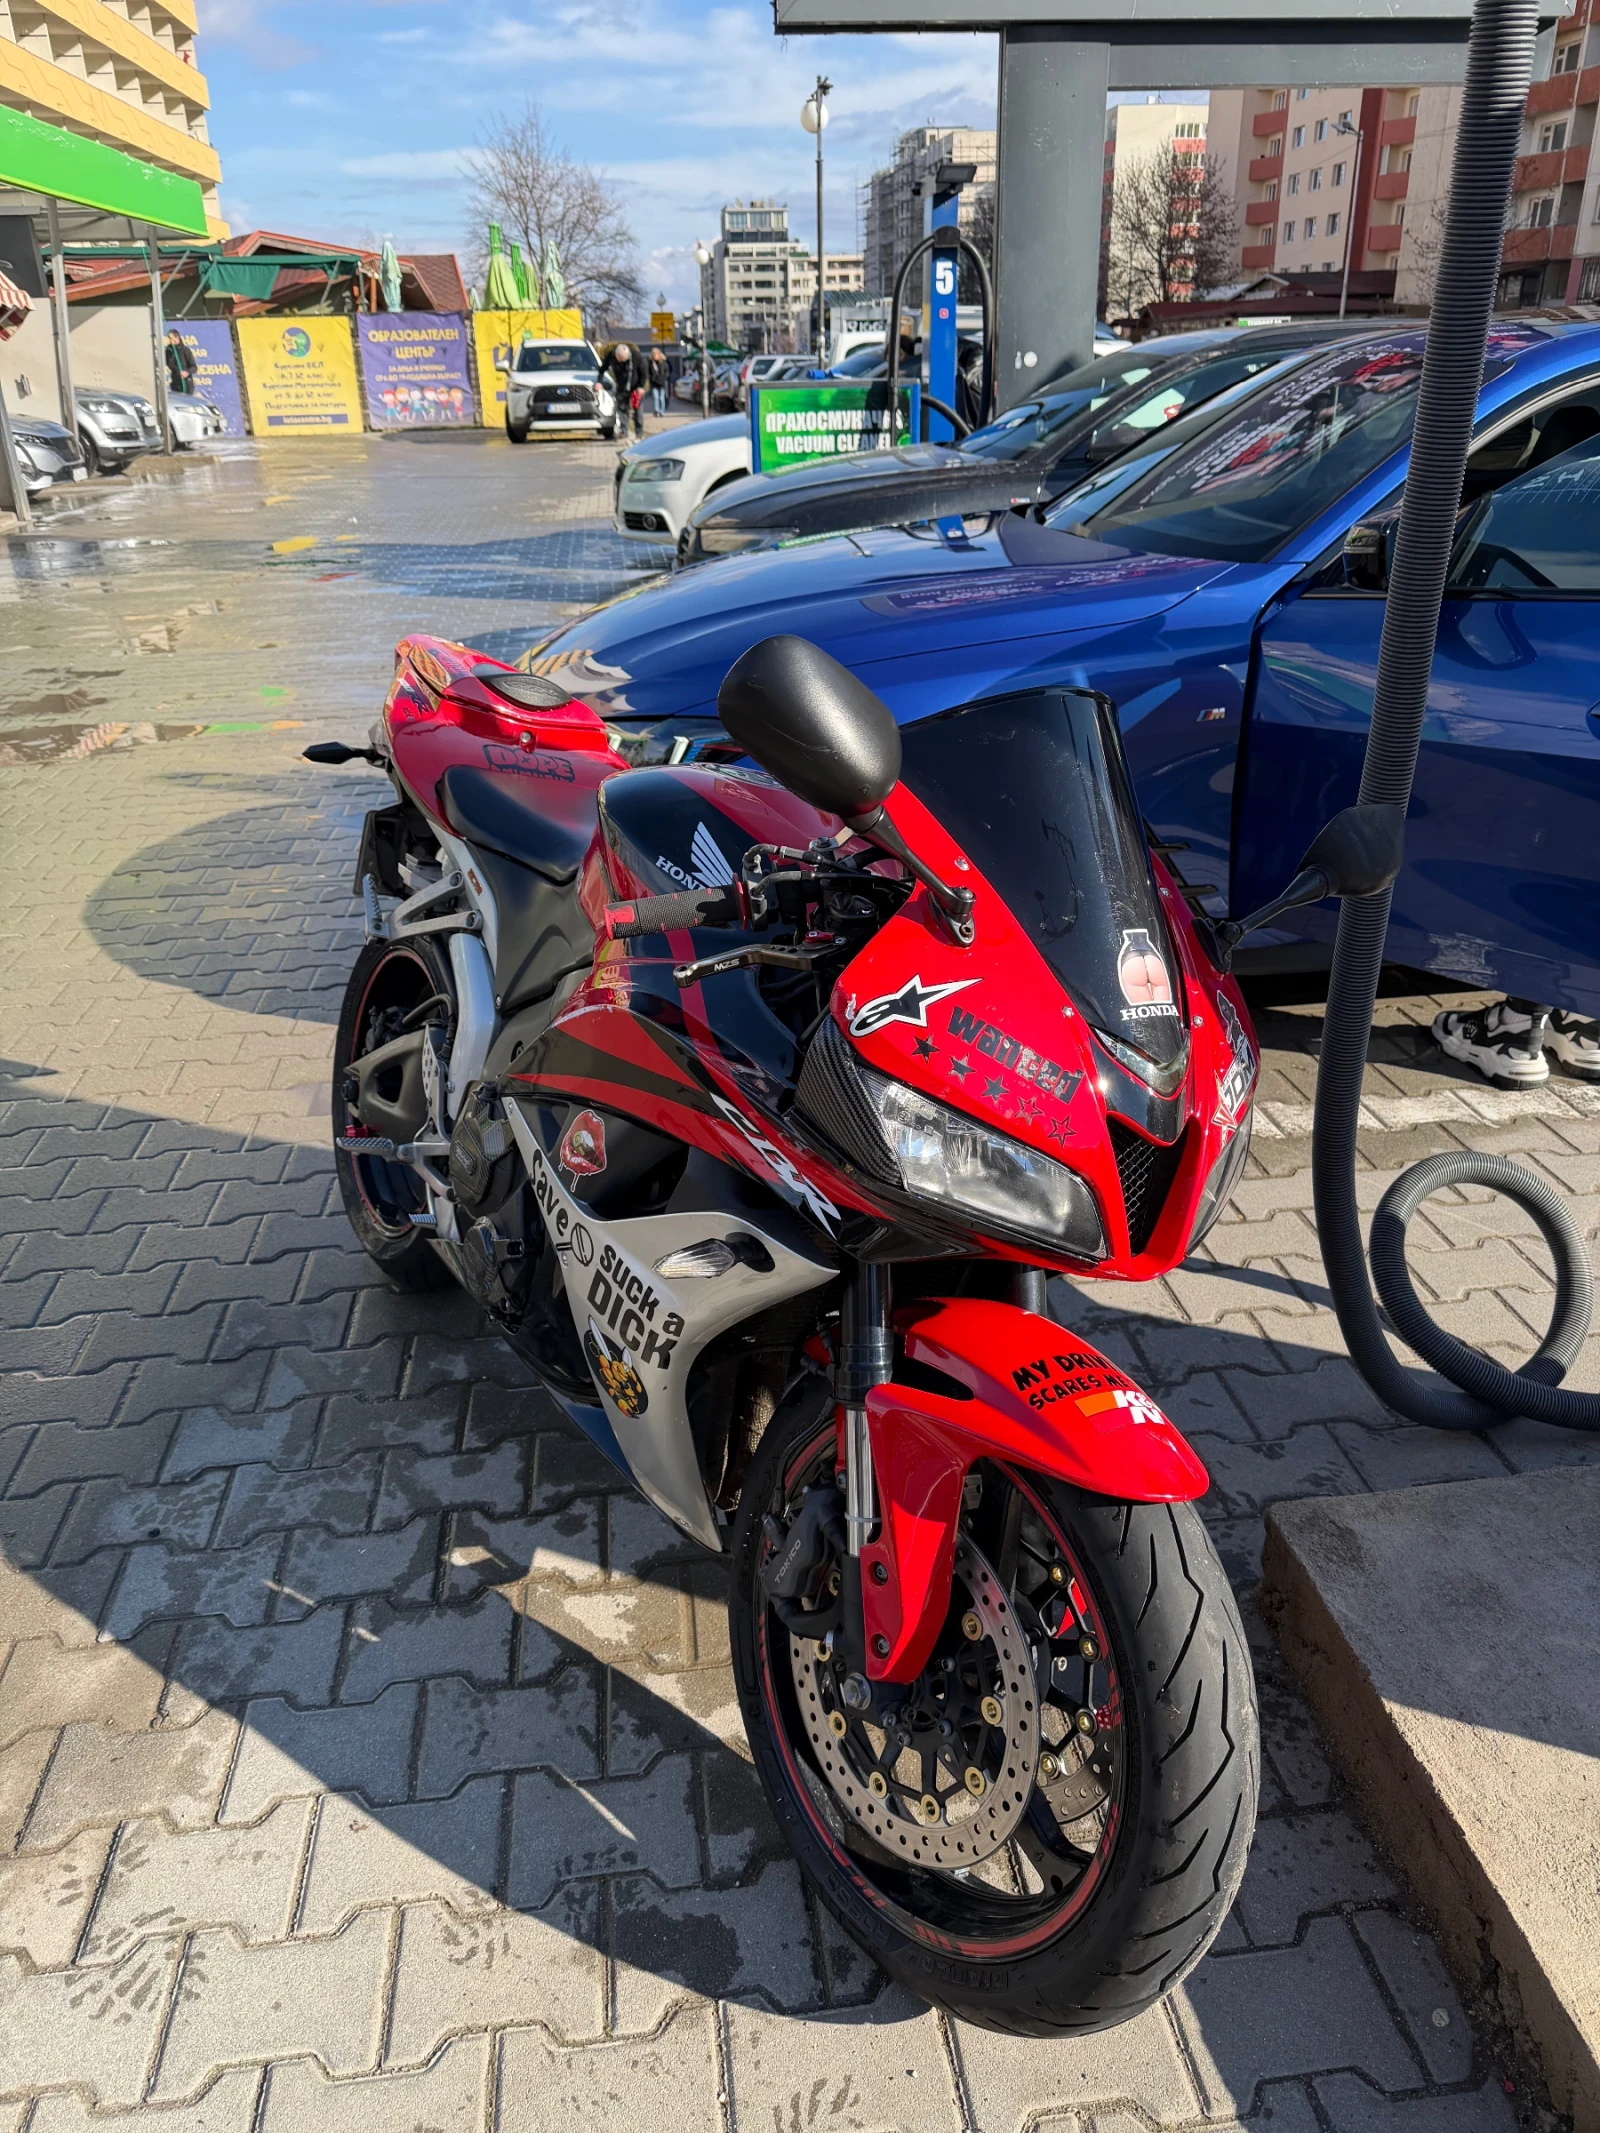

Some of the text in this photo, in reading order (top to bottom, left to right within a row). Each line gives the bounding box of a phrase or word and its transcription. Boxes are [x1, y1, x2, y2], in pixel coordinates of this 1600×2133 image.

[936, 261, 953, 295] 5
[368, 328, 459, 342] ОБРАЗОВАТЕЛЕН
[395, 346, 436, 359] ЦЕНТЪР
[775, 434, 835, 454] VACUUM
[482, 744, 576, 783] DOPE
[655, 856, 706, 890] HON
[714, 958, 740, 971] MZS
[1120, 1005, 1180, 1020] HONDA
[709, 1091, 842, 1240] CBR
[587, 1268, 678, 1370] DICK
[662, 1312, 685, 1338] a
[1011, 1359, 1051, 1392] MY
[1028, 1374, 1103, 1411] SCARES
[774, 1538, 802, 1583] TOKICO
